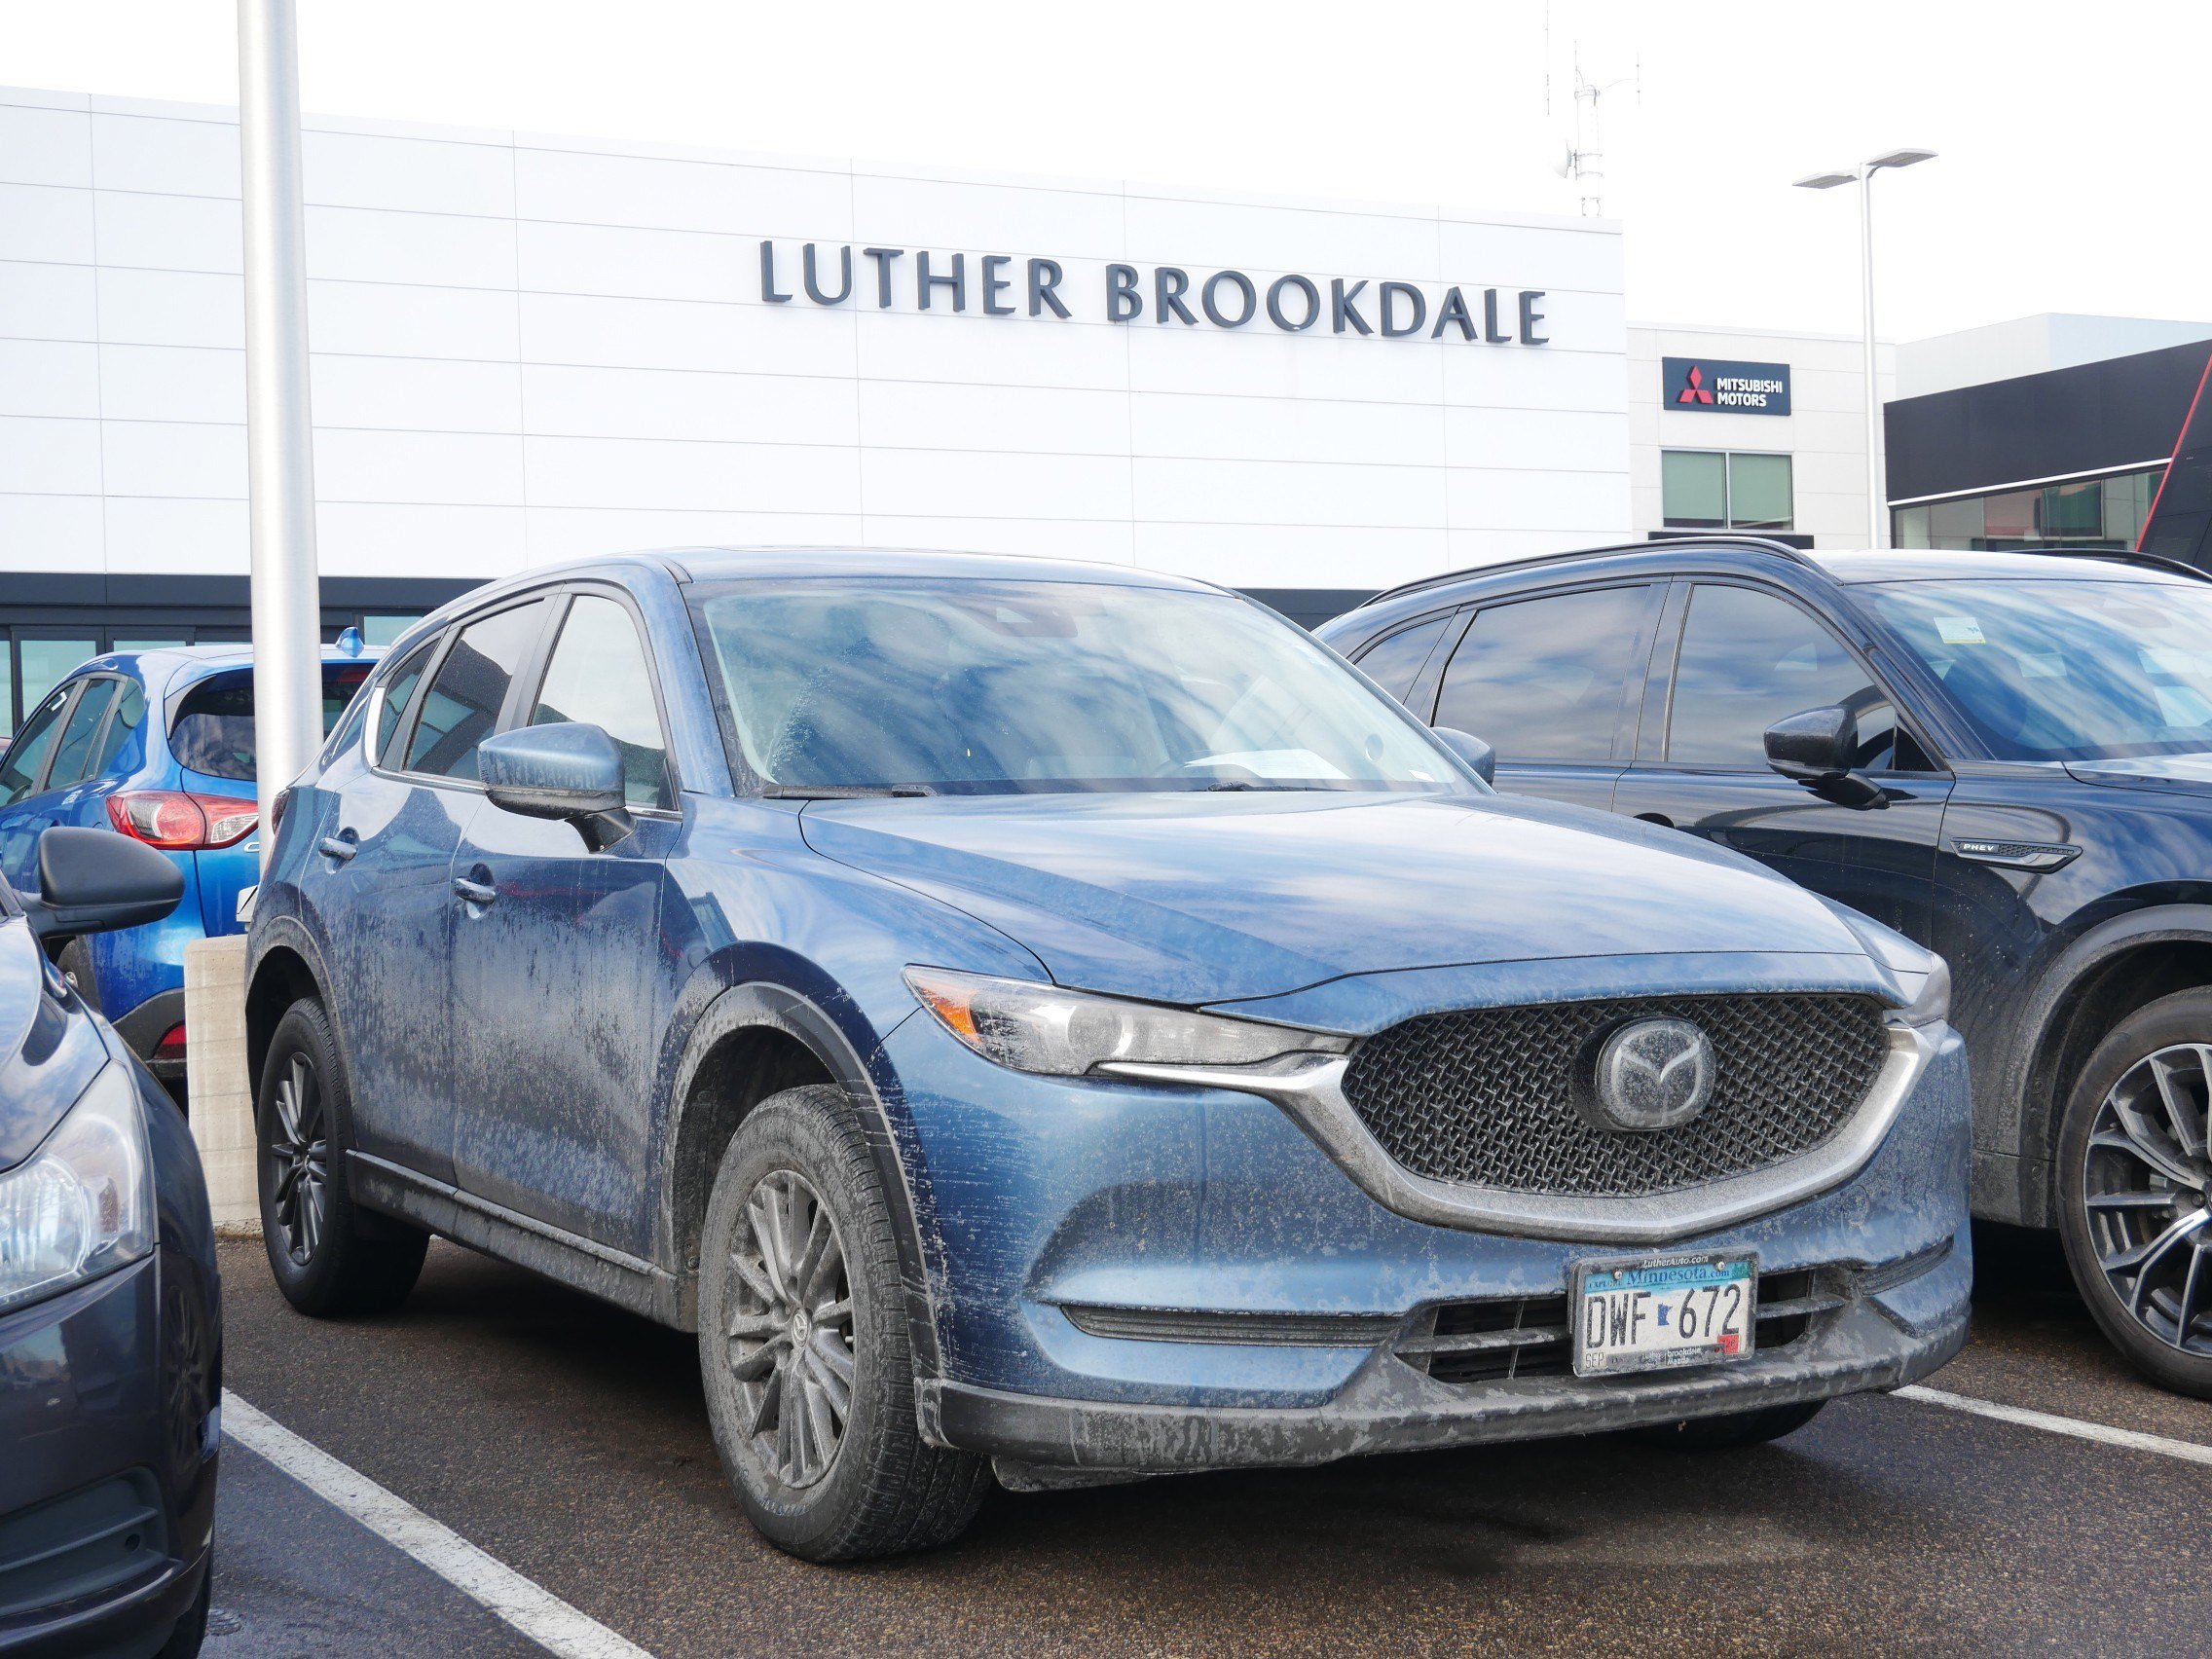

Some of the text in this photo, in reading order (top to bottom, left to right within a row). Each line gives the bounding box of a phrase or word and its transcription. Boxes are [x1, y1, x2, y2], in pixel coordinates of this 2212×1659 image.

[759, 240, 1550, 345] LUTHER BROOKDALE
[1716, 377, 1783, 394] MITSUBISHI
[1716, 391, 1767, 407] MOTORS
[1643, 1255, 1709, 1269] LutherAuto.com
[1586, 1284, 1740, 1349] DWF 672
[1585, 1351, 1604, 1369] SEP
